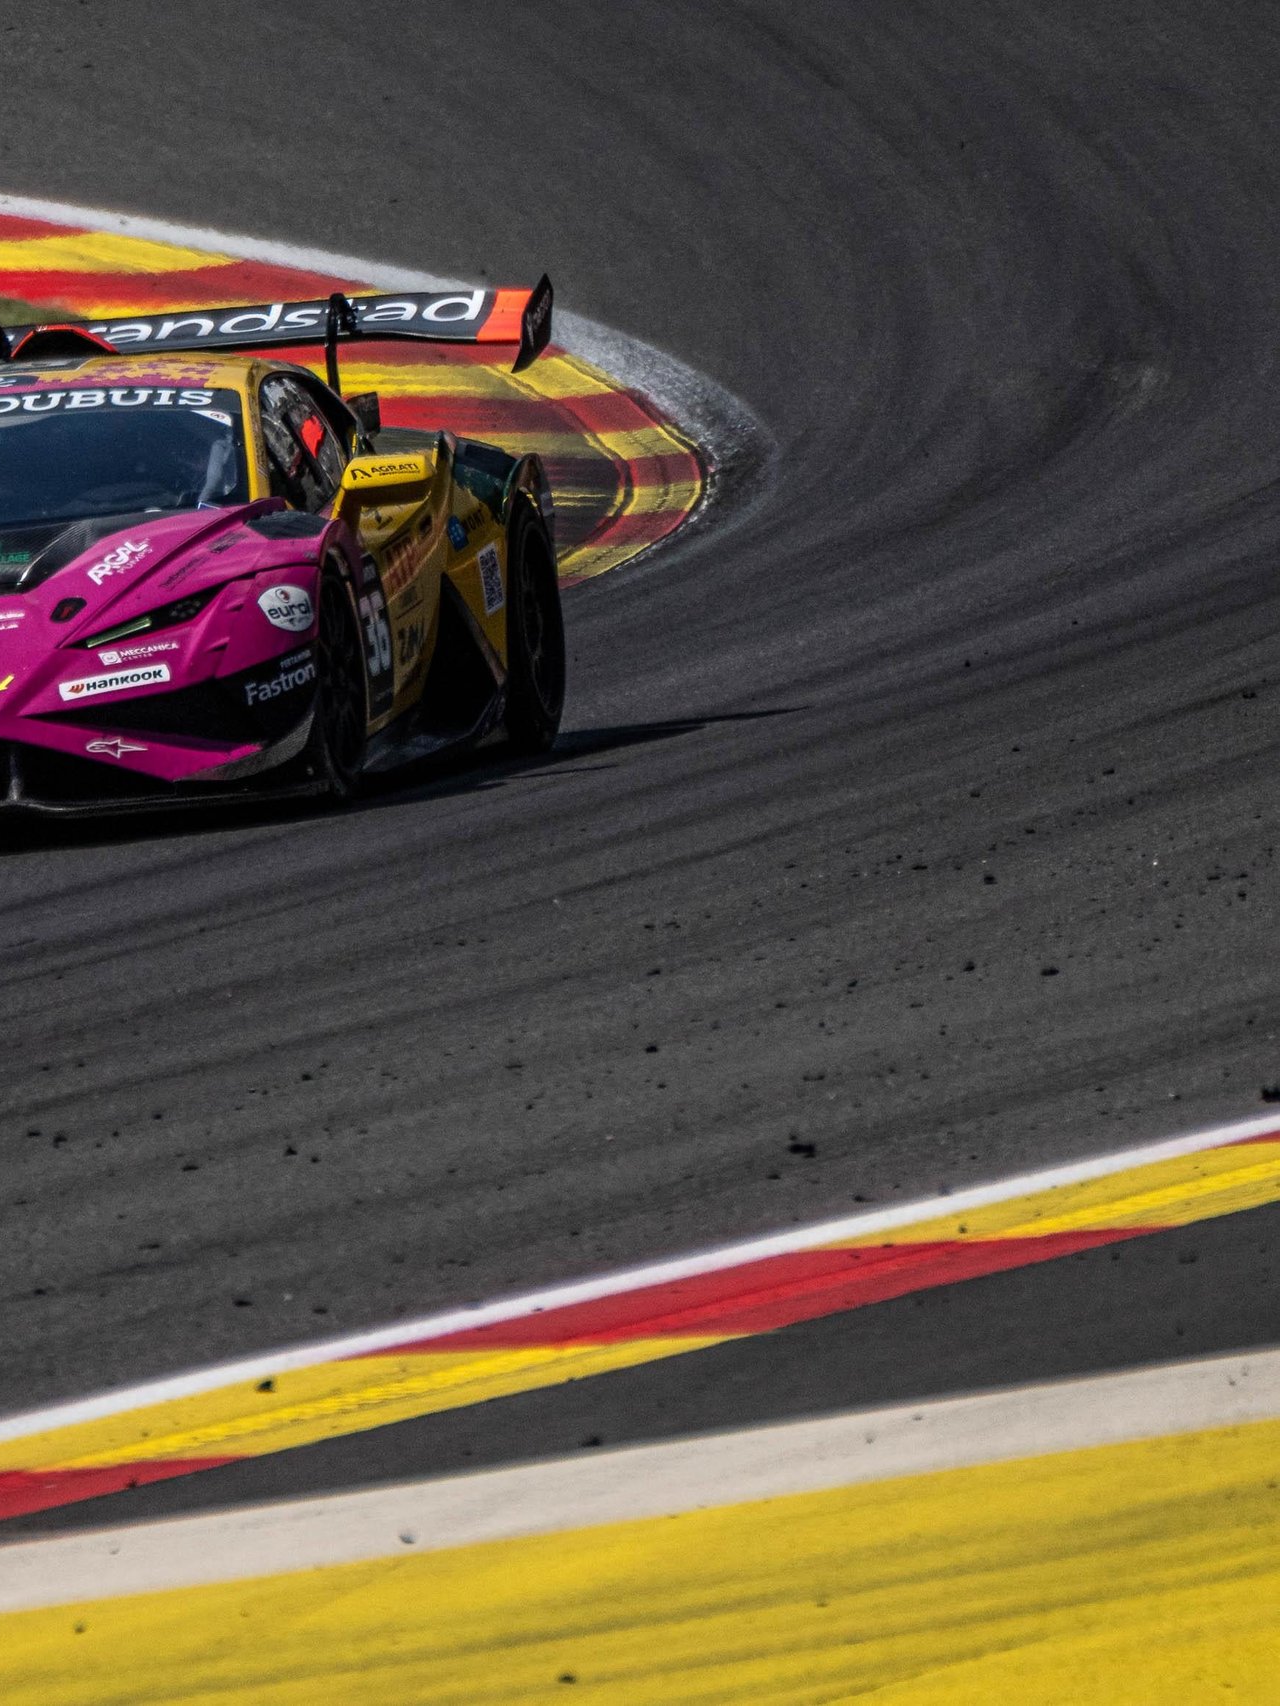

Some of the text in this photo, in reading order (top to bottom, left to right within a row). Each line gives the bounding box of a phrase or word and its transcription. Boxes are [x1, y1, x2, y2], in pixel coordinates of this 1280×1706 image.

[371, 462, 419, 473] AGRATI
[87, 541, 150, 586] ARGAL
[120, 643, 179, 657] MECCANICA
[245, 663, 317, 706] Fastron
